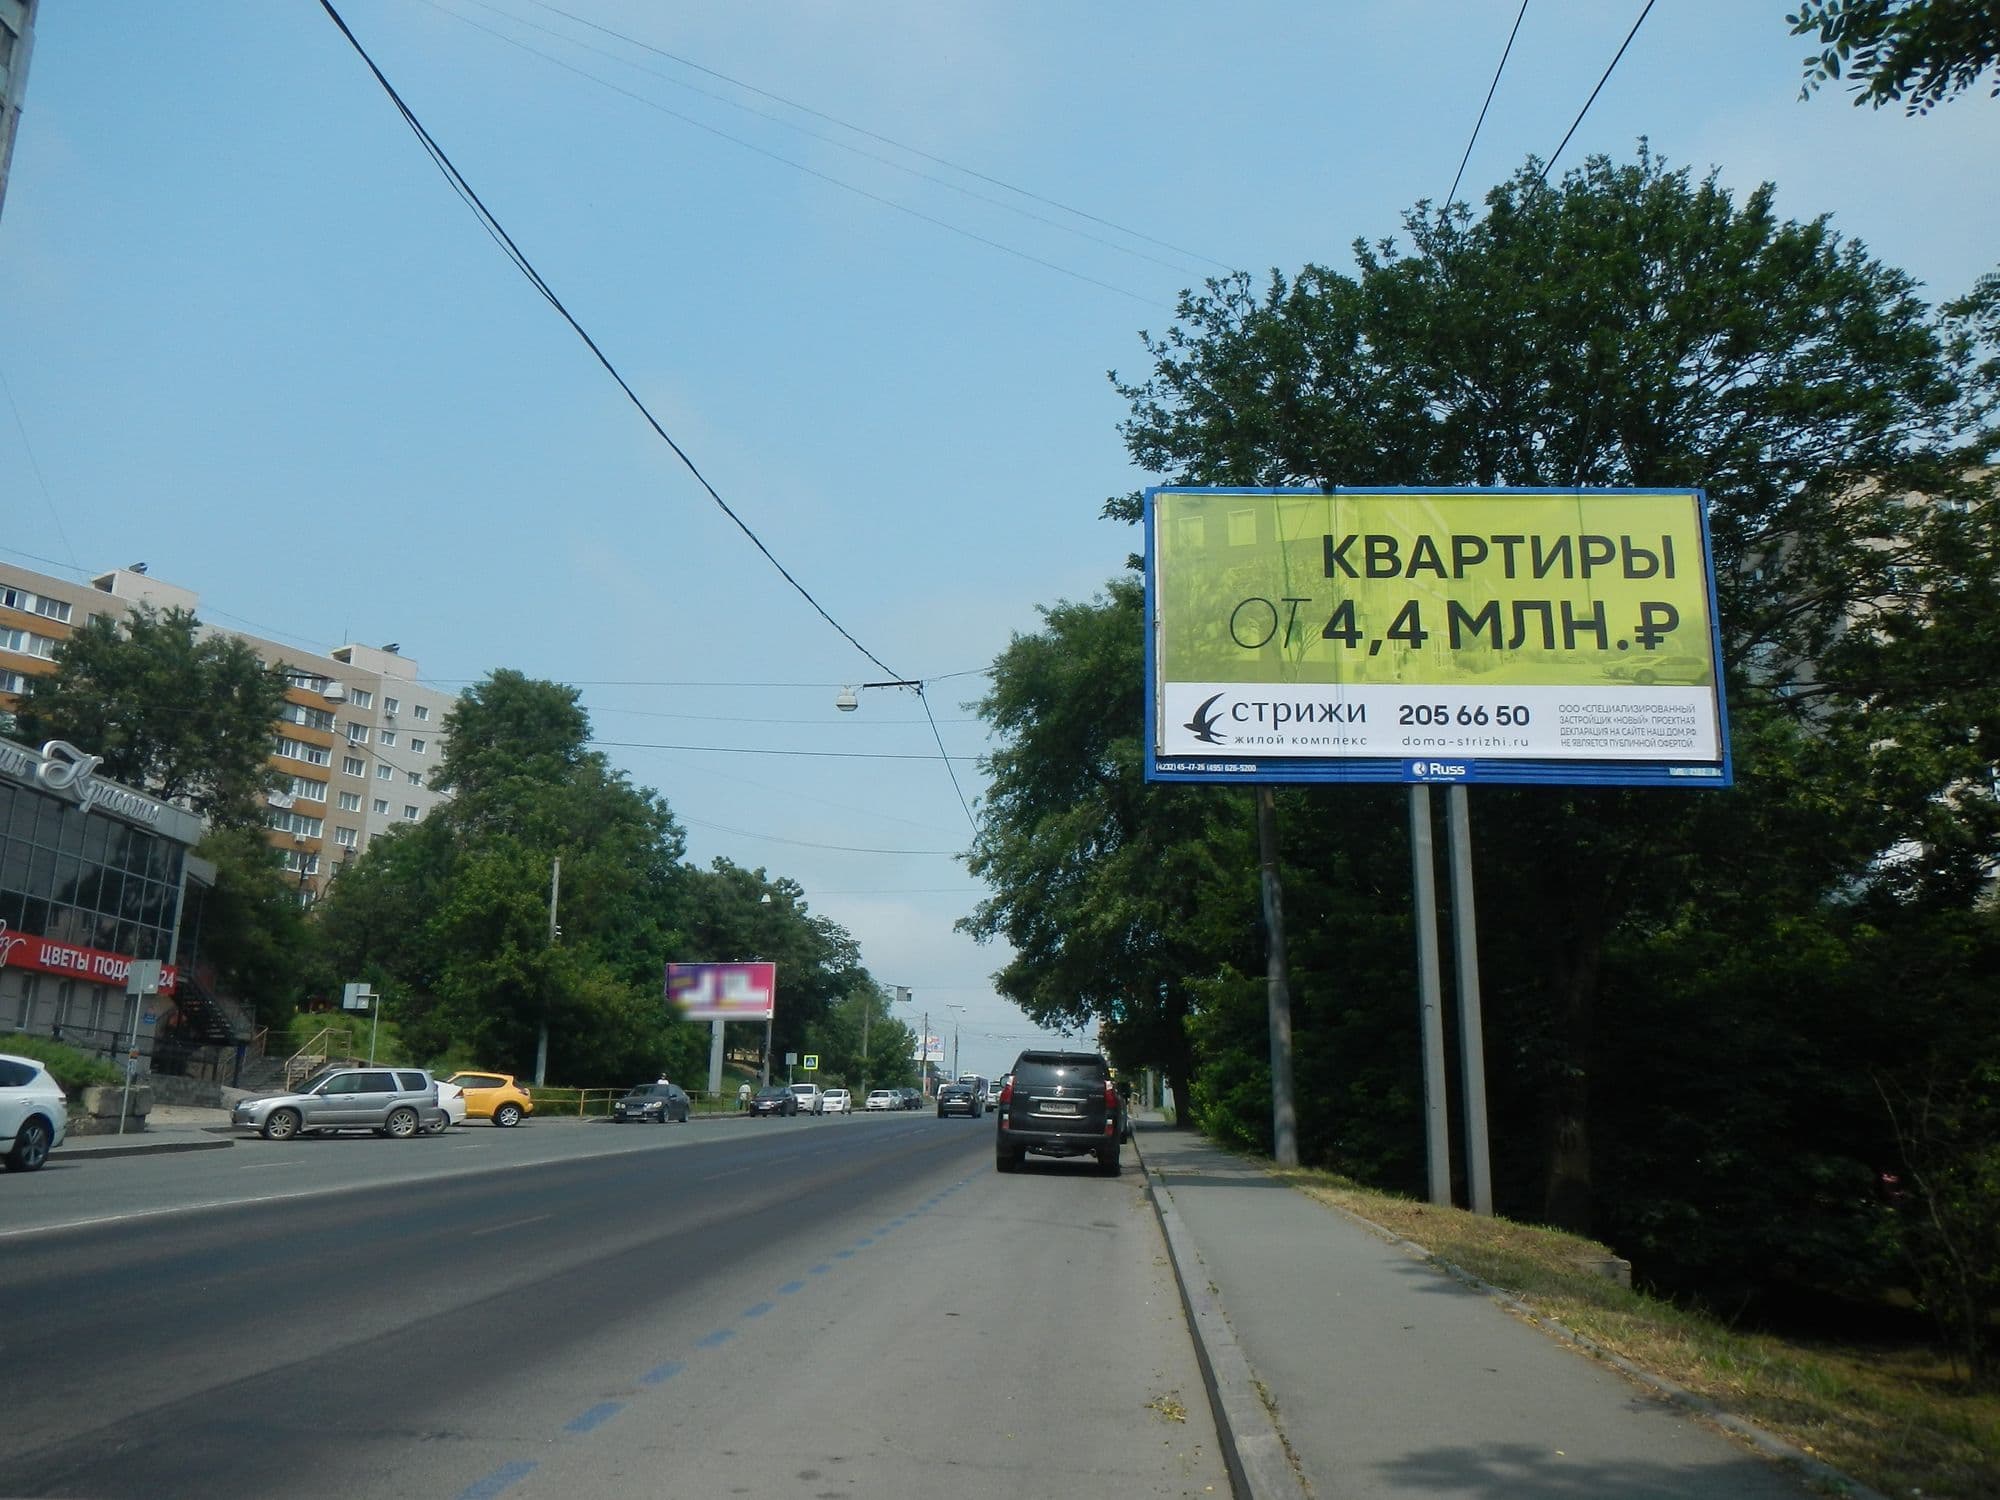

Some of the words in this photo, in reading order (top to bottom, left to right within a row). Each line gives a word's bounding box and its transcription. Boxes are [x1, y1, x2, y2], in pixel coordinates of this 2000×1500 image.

[1322, 534, 1676, 580] КВАРТИРЫ
[1229, 597, 1313, 649] ОТ
[1321, 599, 1429, 656] 4,4
[1558, 704, 1581, 713] ООО
[1231, 702, 1367, 731] стрижи
[1398, 704, 1450, 726] 205
[1456, 705, 1489, 726] 66
[1495, 705, 1530, 726] 50
[1559, 715, 1612, 725] ЗАСТРОЙЩИК
[1651, 715, 1696, 725] ПРОЕКТНАЯ
[1560, 727, 1609, 737] ДЕКЛАРАЦИЯ
[1609, 727, 1620, 736] НА
[1621, 727, 1646, 736] САЙТЕ
[1234, 734, 1285, 745] жилой
[1291, 736, 1368, 746] комплекс
[1402, 736, 1529, 747] doma-strizhi.ru
[1561, 739, 1571, 748] НЕ
[1571, 738, 1609, 748] ЯВЛЯЕТСЯ
[1609, 738, 1656, 748] ПУБЛИЧНОЙ
[1429, 762, 1466, 775] Russ
[39, 943, 90, 972] ЦВЕТЫ
[159, 970, 175, 988] 24
